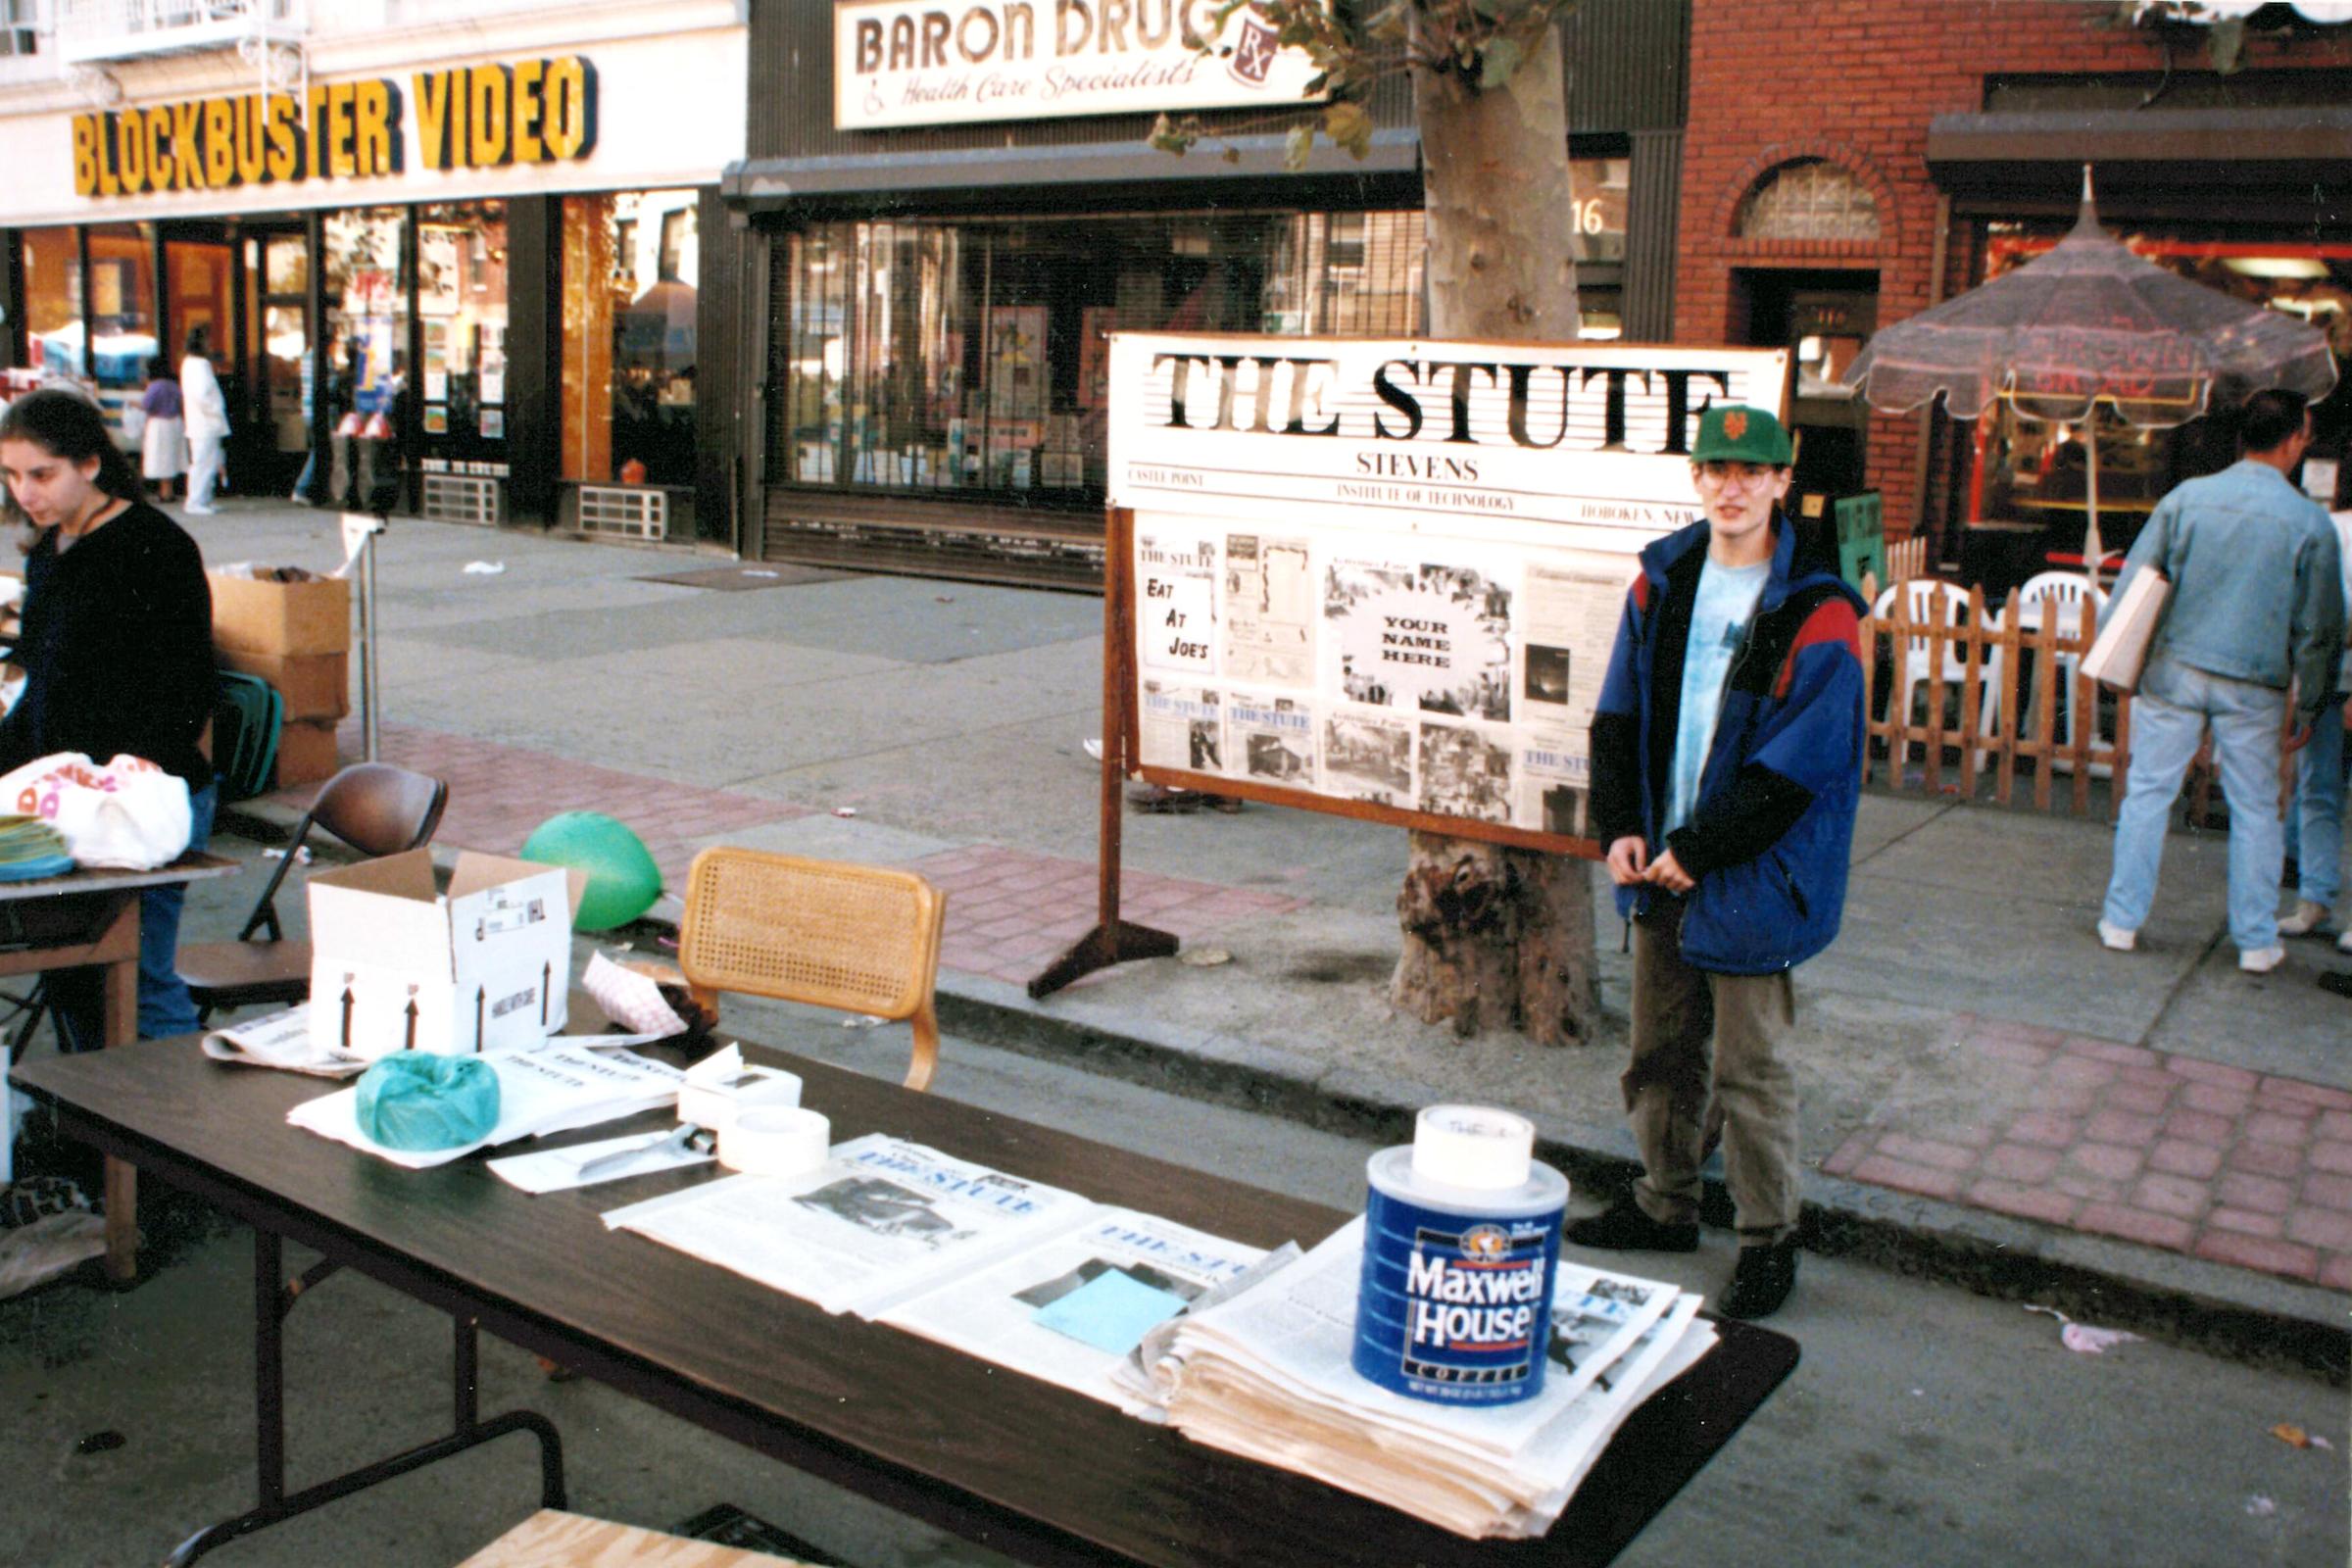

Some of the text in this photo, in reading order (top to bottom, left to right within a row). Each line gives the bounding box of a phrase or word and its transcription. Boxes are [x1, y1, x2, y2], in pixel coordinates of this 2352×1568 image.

[903, 60, 1200, 105] Health Care Specialists
[73, 55, 599, 197] BLOCKBUSTER VIDEO
[1152, 353, 1729, 456] THE STUTE
[1356, 452, 1479, 481] STEVENS
[1128, 469, 1203, 487] CASTLE POINT
[1337, 484, 1515, 511] INSTITUTE OF TECHNOLOGY
[1141, 550, 1165, 564] THE
[1147, 578, 1174, 600] EAT
[1165, 609, 1187, 628] AT
[1384, 615, 1448, 634] YOUR
[1169, 637, 1209, 659] JOE'S
[1383, 633, 1450, 652] NAME
[1383, 650, 1450, 668] HERE
[1229, 707, 1257, 722] THE
[1406, 1250, 1545, 1304] Maxwell
[1415, 1299, 1531, 1348] House
[1416, 1363, 1518, 1384] COFFEE
